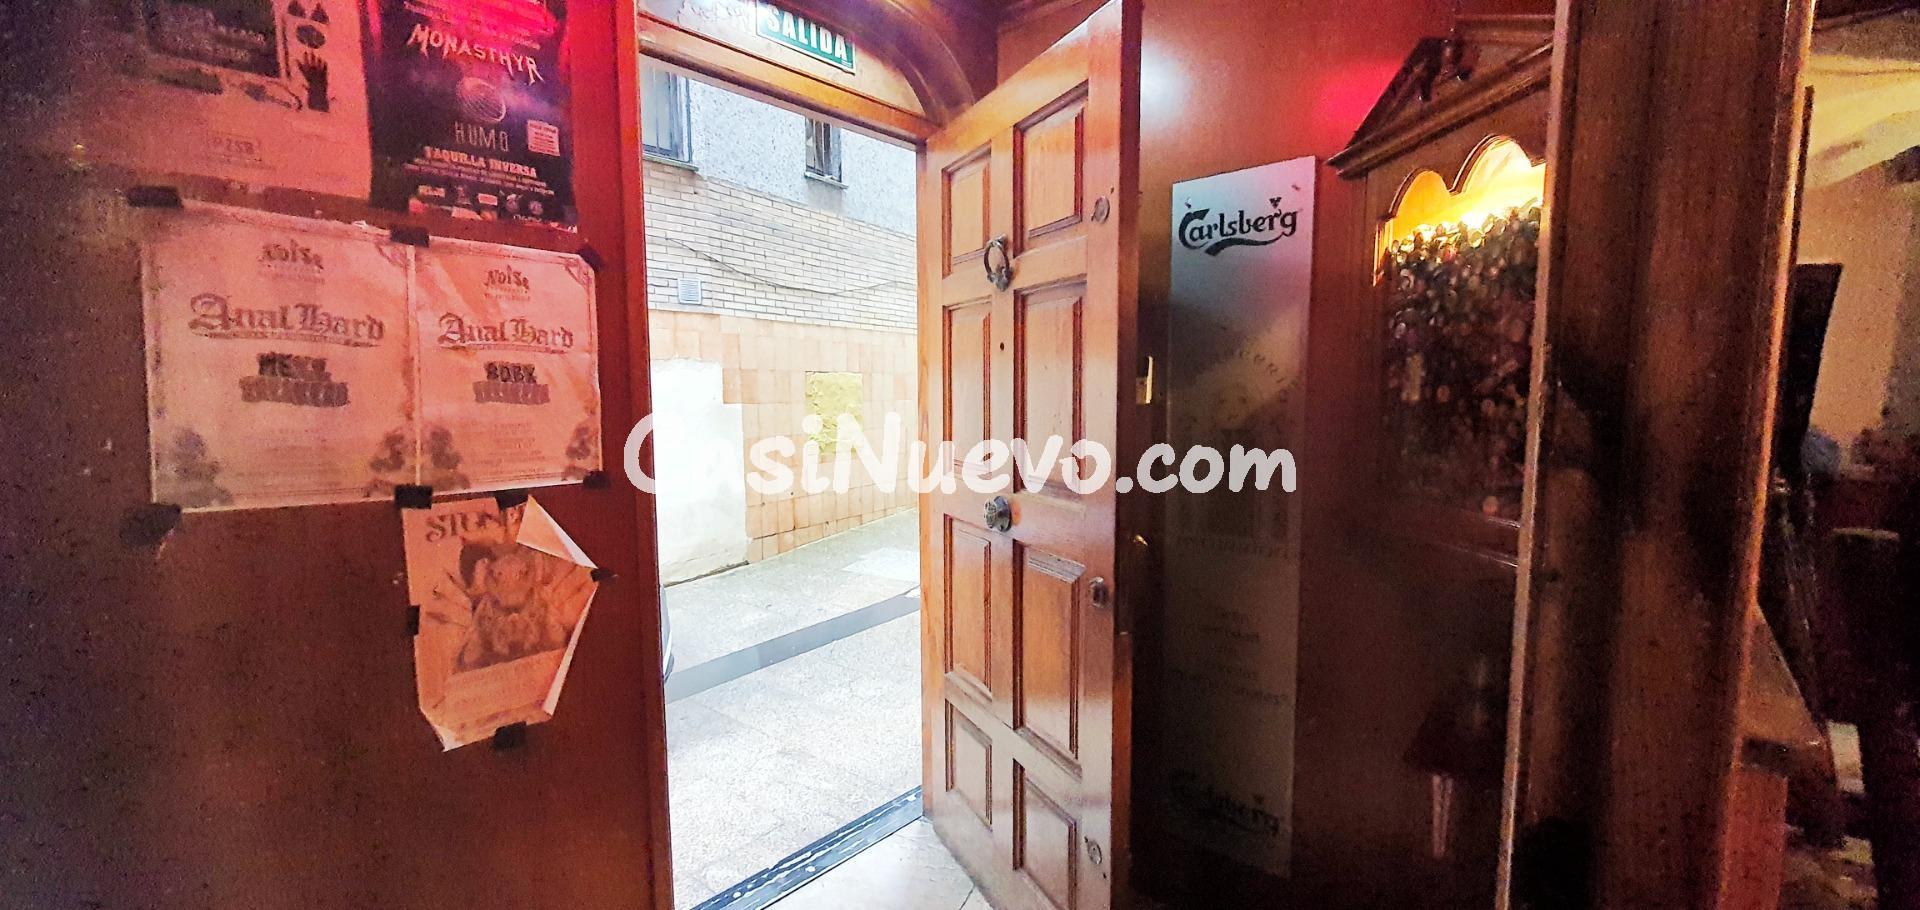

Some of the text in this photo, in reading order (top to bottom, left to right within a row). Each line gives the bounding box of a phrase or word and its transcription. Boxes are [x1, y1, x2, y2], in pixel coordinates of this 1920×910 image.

[407, 24, 544, 86] MONASTHYR
[767, 4, 848, 61] SALIDA
[454, 121, 510, 153] HUMO
[1178, 205, 1298, 253] Carlsberg
[188, 293, 290, 338] Anal
[437, 312, 508, 344] Anal
